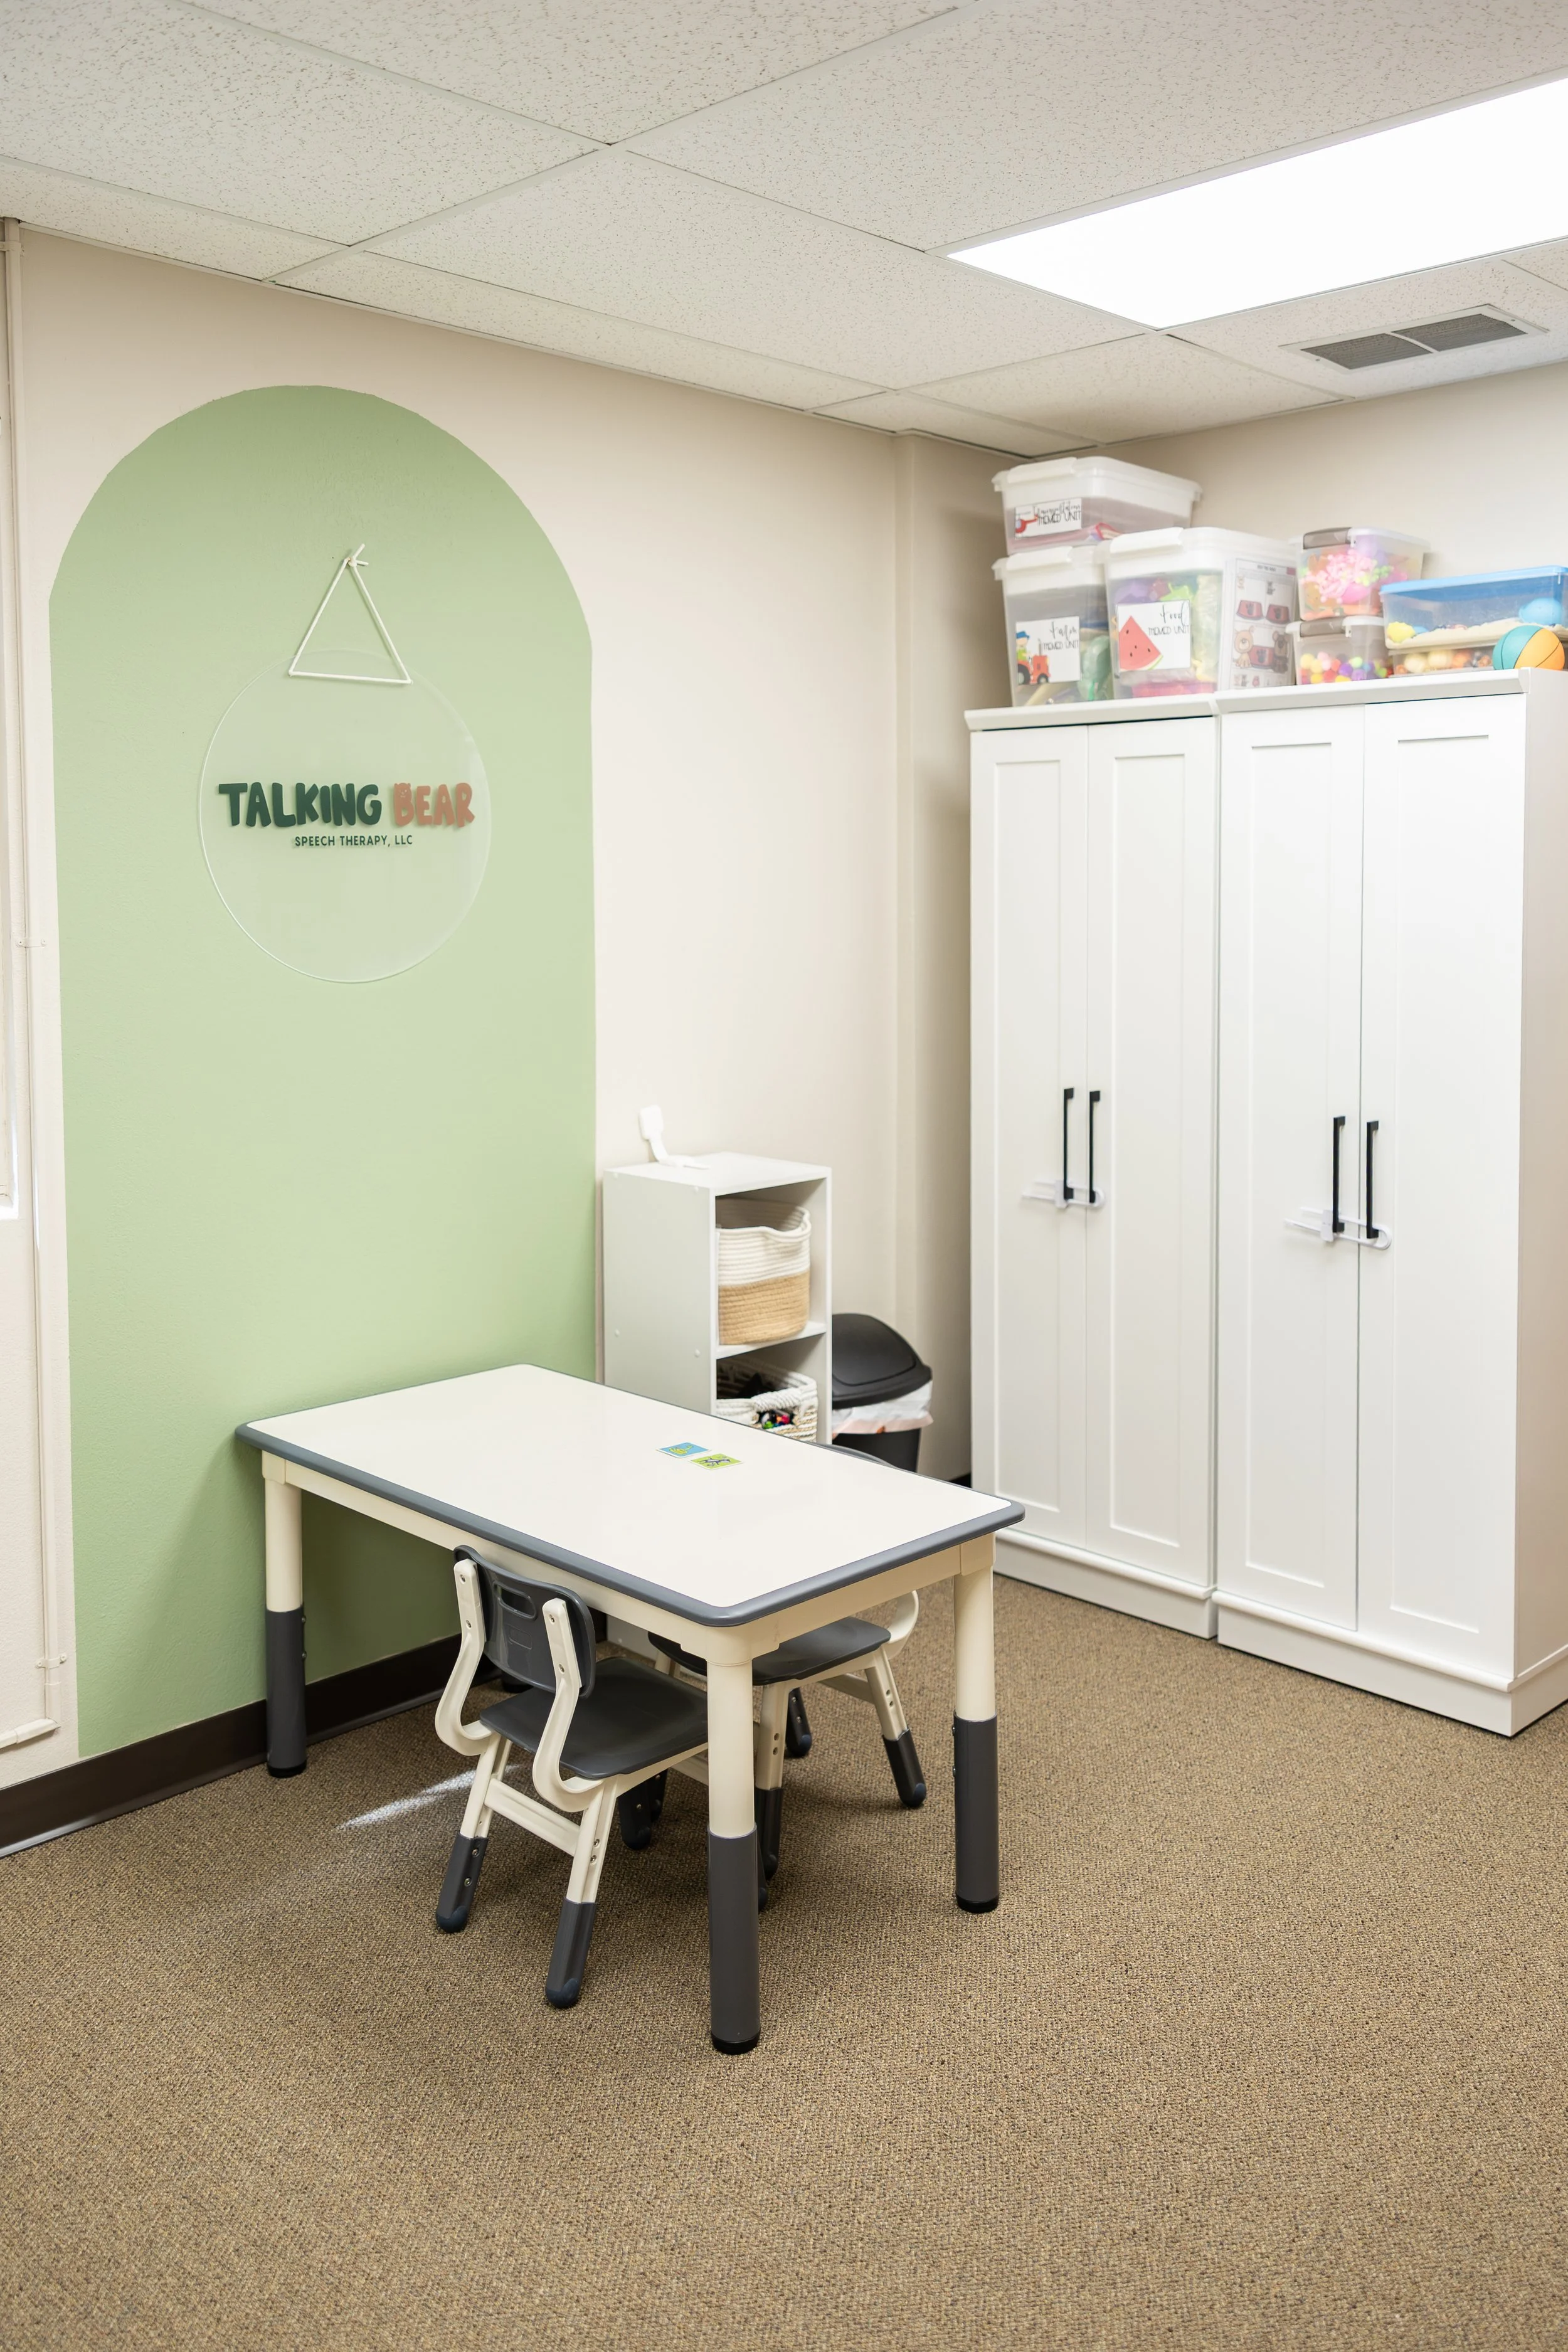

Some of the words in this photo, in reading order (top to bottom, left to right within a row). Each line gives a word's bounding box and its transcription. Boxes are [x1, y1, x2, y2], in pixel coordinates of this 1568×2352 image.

[218, 781, 382, 827] TALKING
[393, 782, 475, 827] BEAR
[295, 835, 336, 847] SPEECH
[339, 835, 391, 847] THERAPY,
[395, 835, 413, 845] LLC
